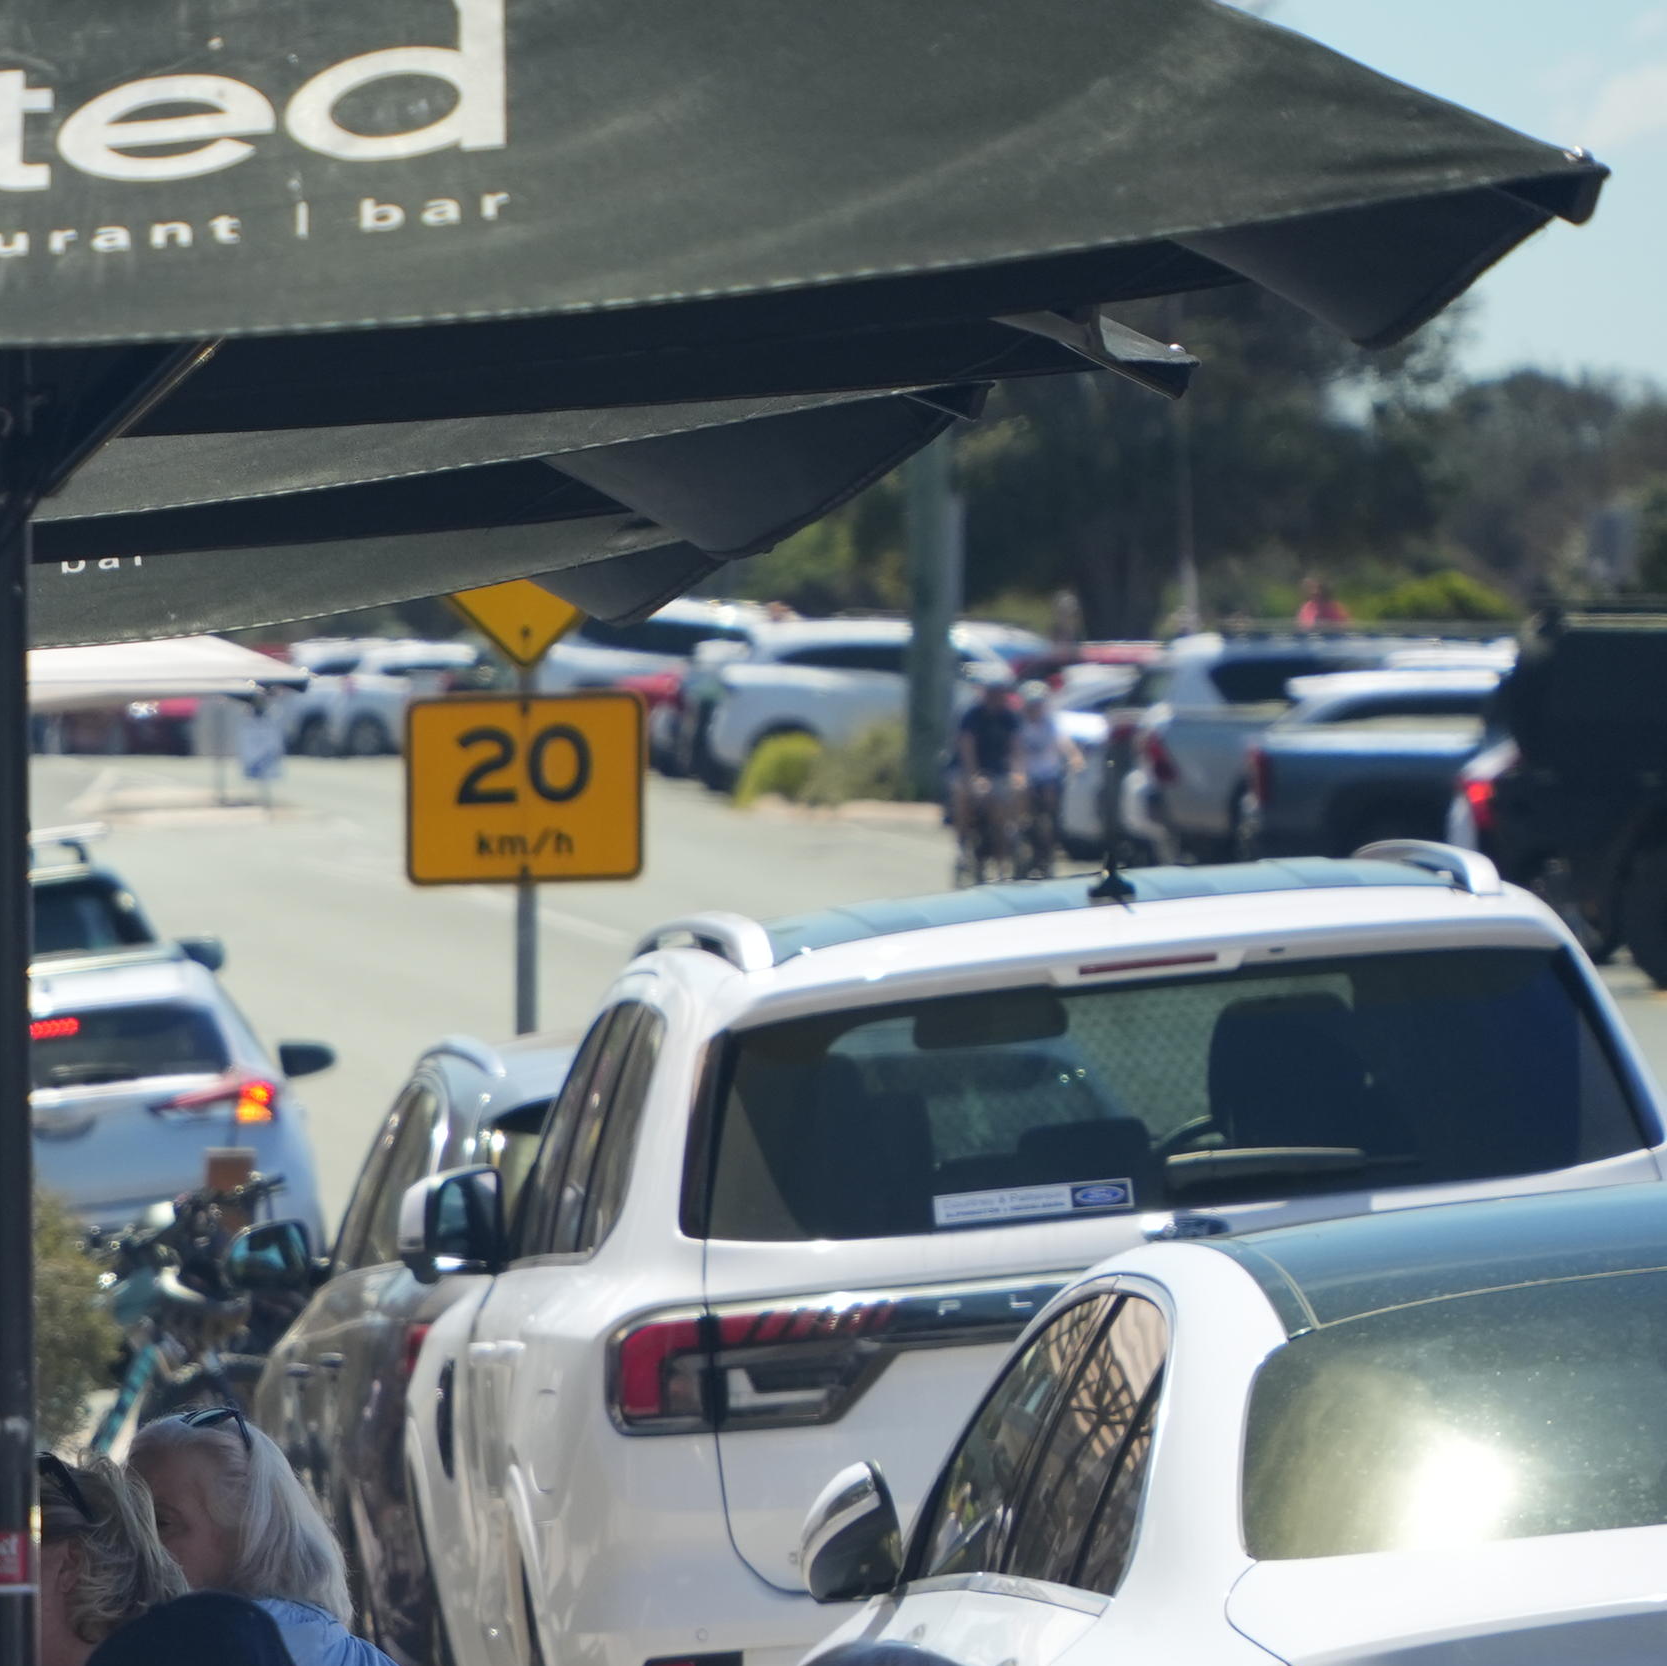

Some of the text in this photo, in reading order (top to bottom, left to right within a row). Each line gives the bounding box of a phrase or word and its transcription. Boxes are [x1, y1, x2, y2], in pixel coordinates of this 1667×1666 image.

[359, 190, 511, 232] bar
[457, 725, 591, 804] 20
[477, 830, 573, 856] km/h
